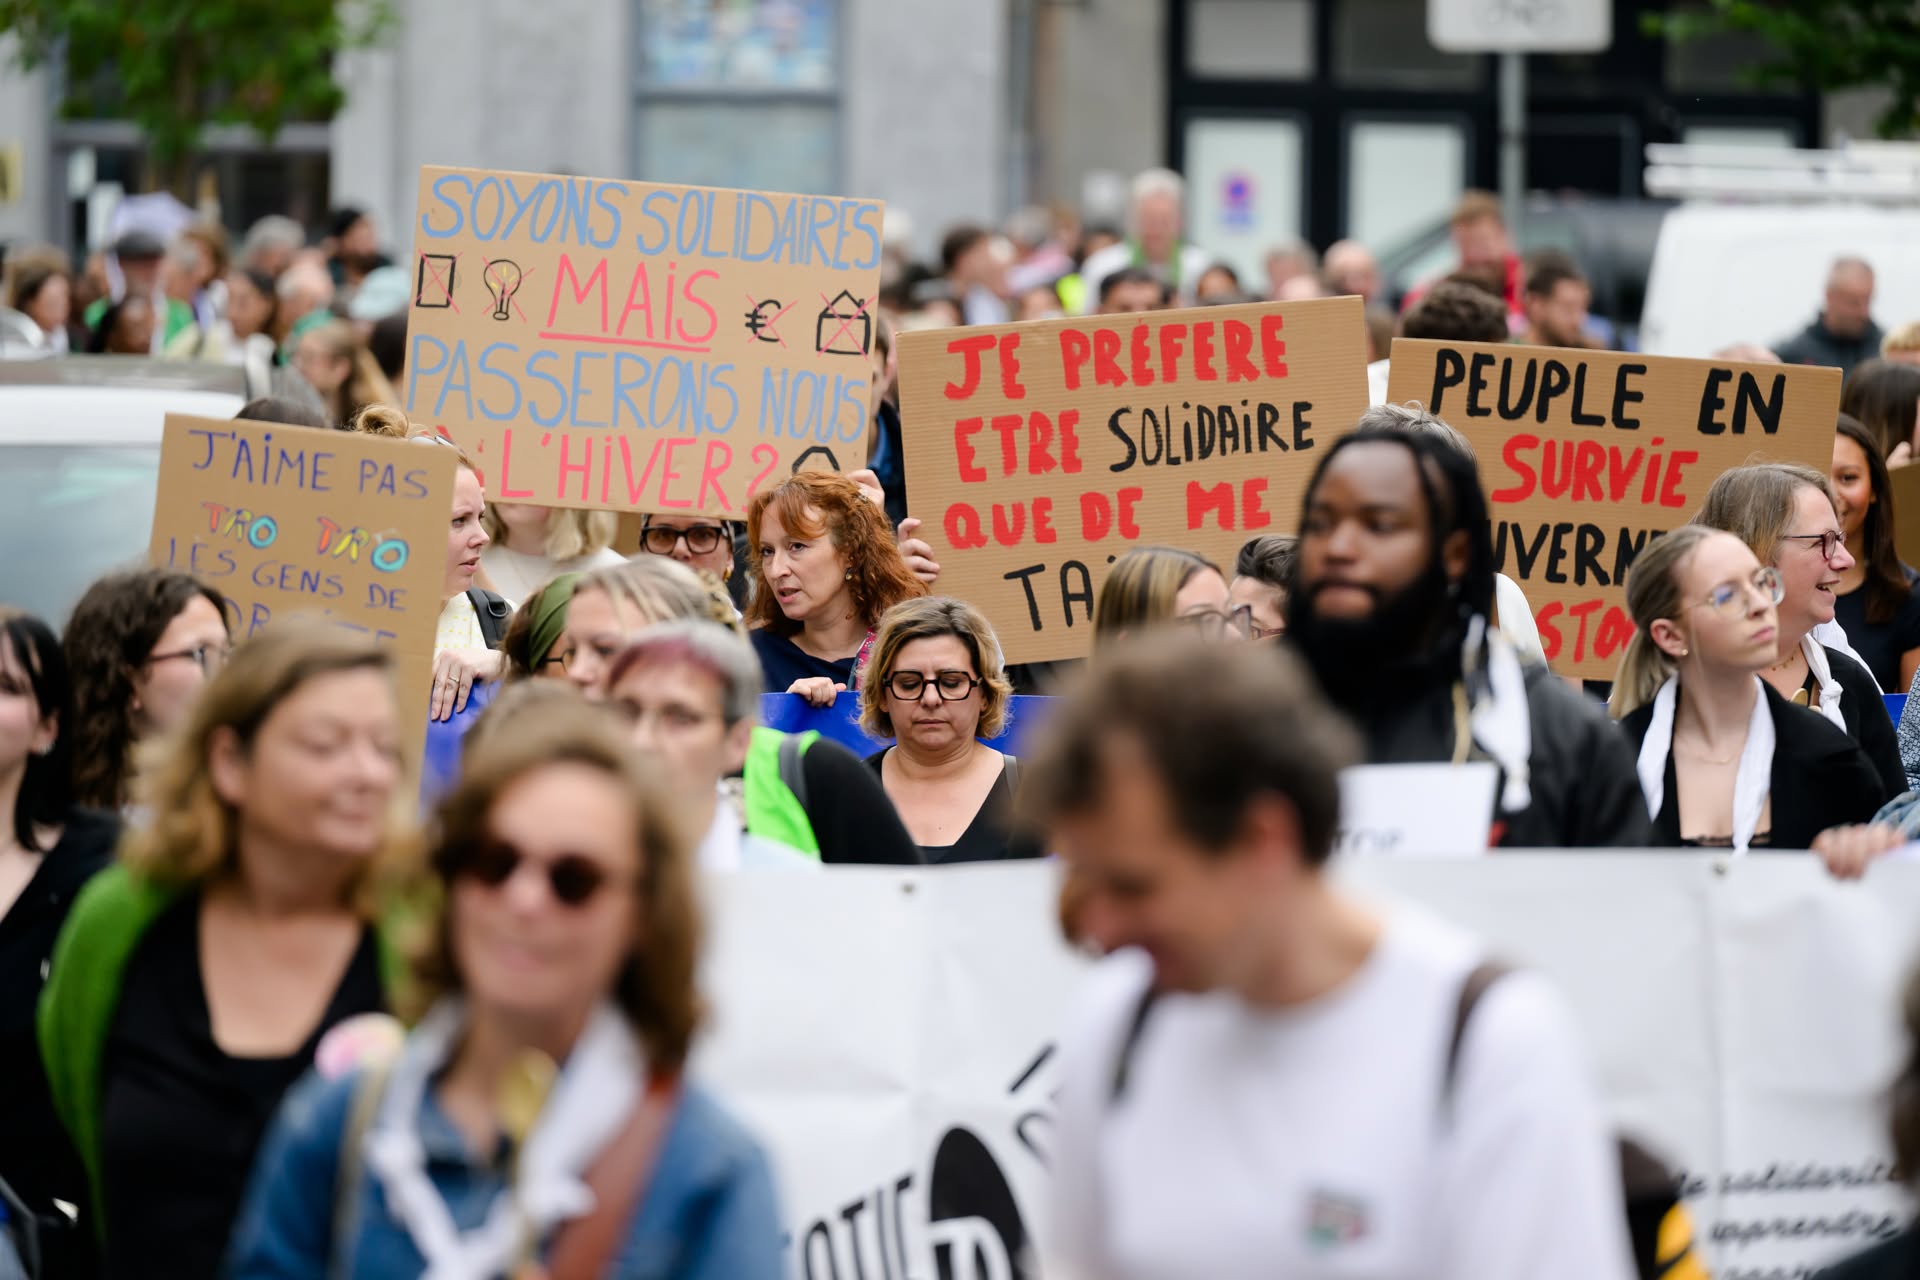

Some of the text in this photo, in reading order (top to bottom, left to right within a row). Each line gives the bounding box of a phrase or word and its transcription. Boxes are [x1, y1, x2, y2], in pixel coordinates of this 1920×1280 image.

[421, 174, 629, 250] SOYONS
[405, 334, 867, 443] PASSERONS NOUS
[943, 331, 1026, 400] JE
[1430, 348, 1786, 435] PEUPLE EN
[359, 458, 429, 500] PAS
[954, 408, 1083, 483] ETRE
[201, 502, 411, 573] TRO TRO
[943, 476, 1271, 550] QUE DE ME
[251, 559, 345, 599] GENS
[364, 582, 408, 612] DE
